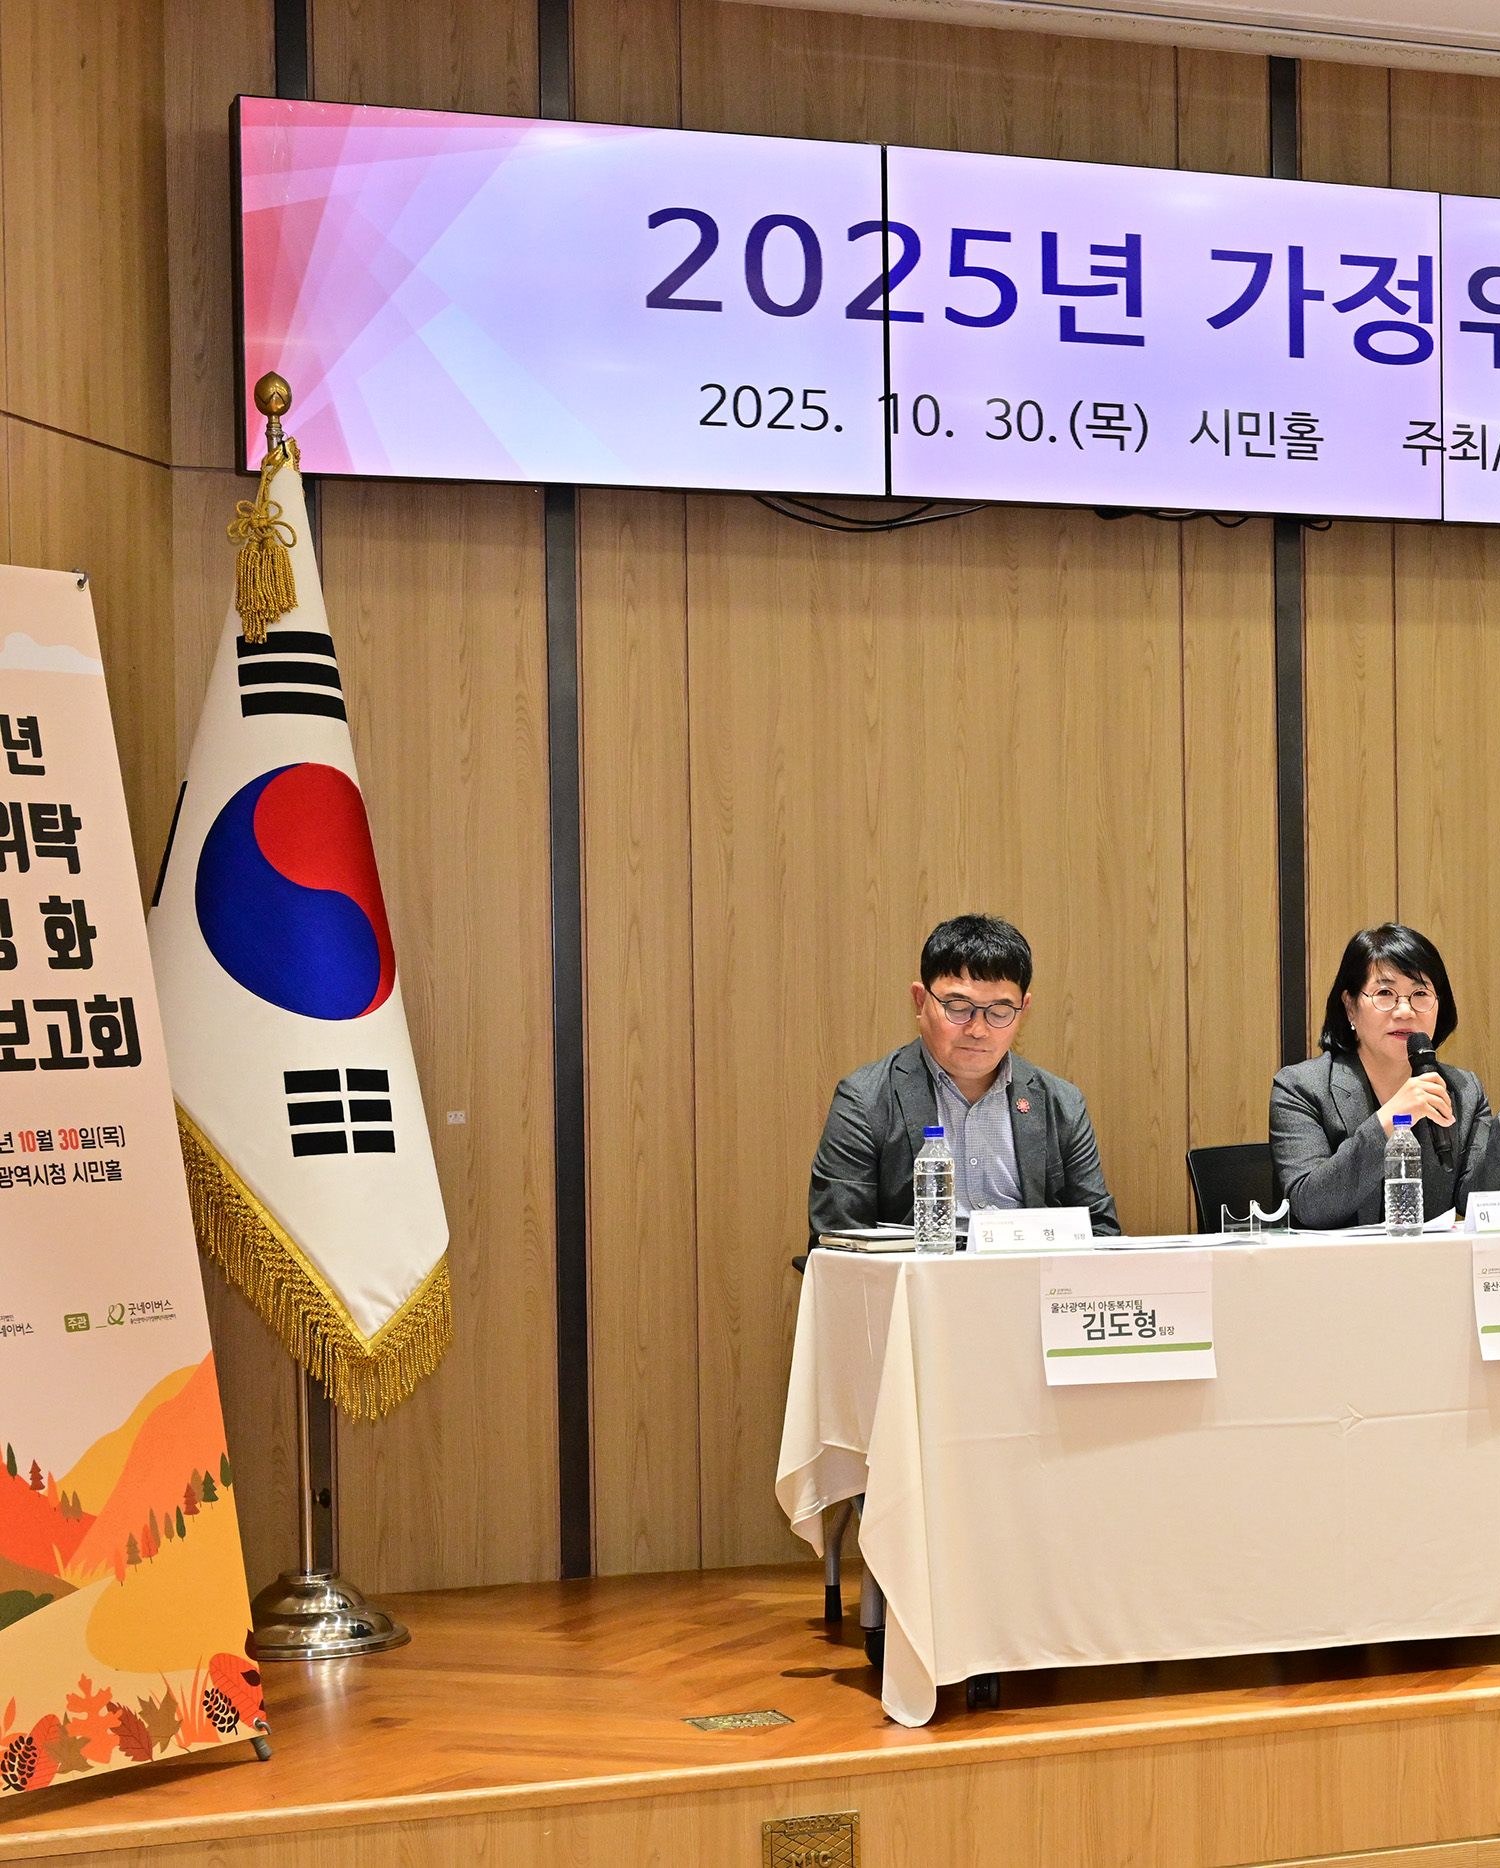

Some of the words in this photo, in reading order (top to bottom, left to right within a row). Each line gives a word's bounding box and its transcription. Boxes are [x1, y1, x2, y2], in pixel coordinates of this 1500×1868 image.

[646, 207, 1145, 346] 2025년
[699, 383, 843, 433] 2025.
[878, 393, 954, 438] 10.
[1190, 408, 1325, 462] 시민홀
[39, 895, 97, 971] 화
[0, 993, 142, 1071] 보고회
[18, 1130, 54, 1152] 10월
[58, 1125, 125, 1151] 30일(목)
[0, 1163, 66, 1188] 광역시청
[73, 1160, 122, 1183] 시민홀
[128, 1300, 173, 1316] 굿네이버스
[1051, 1301, 1096, 1313] 울산광역시
[1098, 1299, 1143, 1312] 아동복지팀
[67, 1317, 87, 1330] 주관
[1082, 1309, 1157, 1341] 김도형
[1159, 1325, 1175, 1336] 팀장
[791, 1851, 834, 1868] MIC
